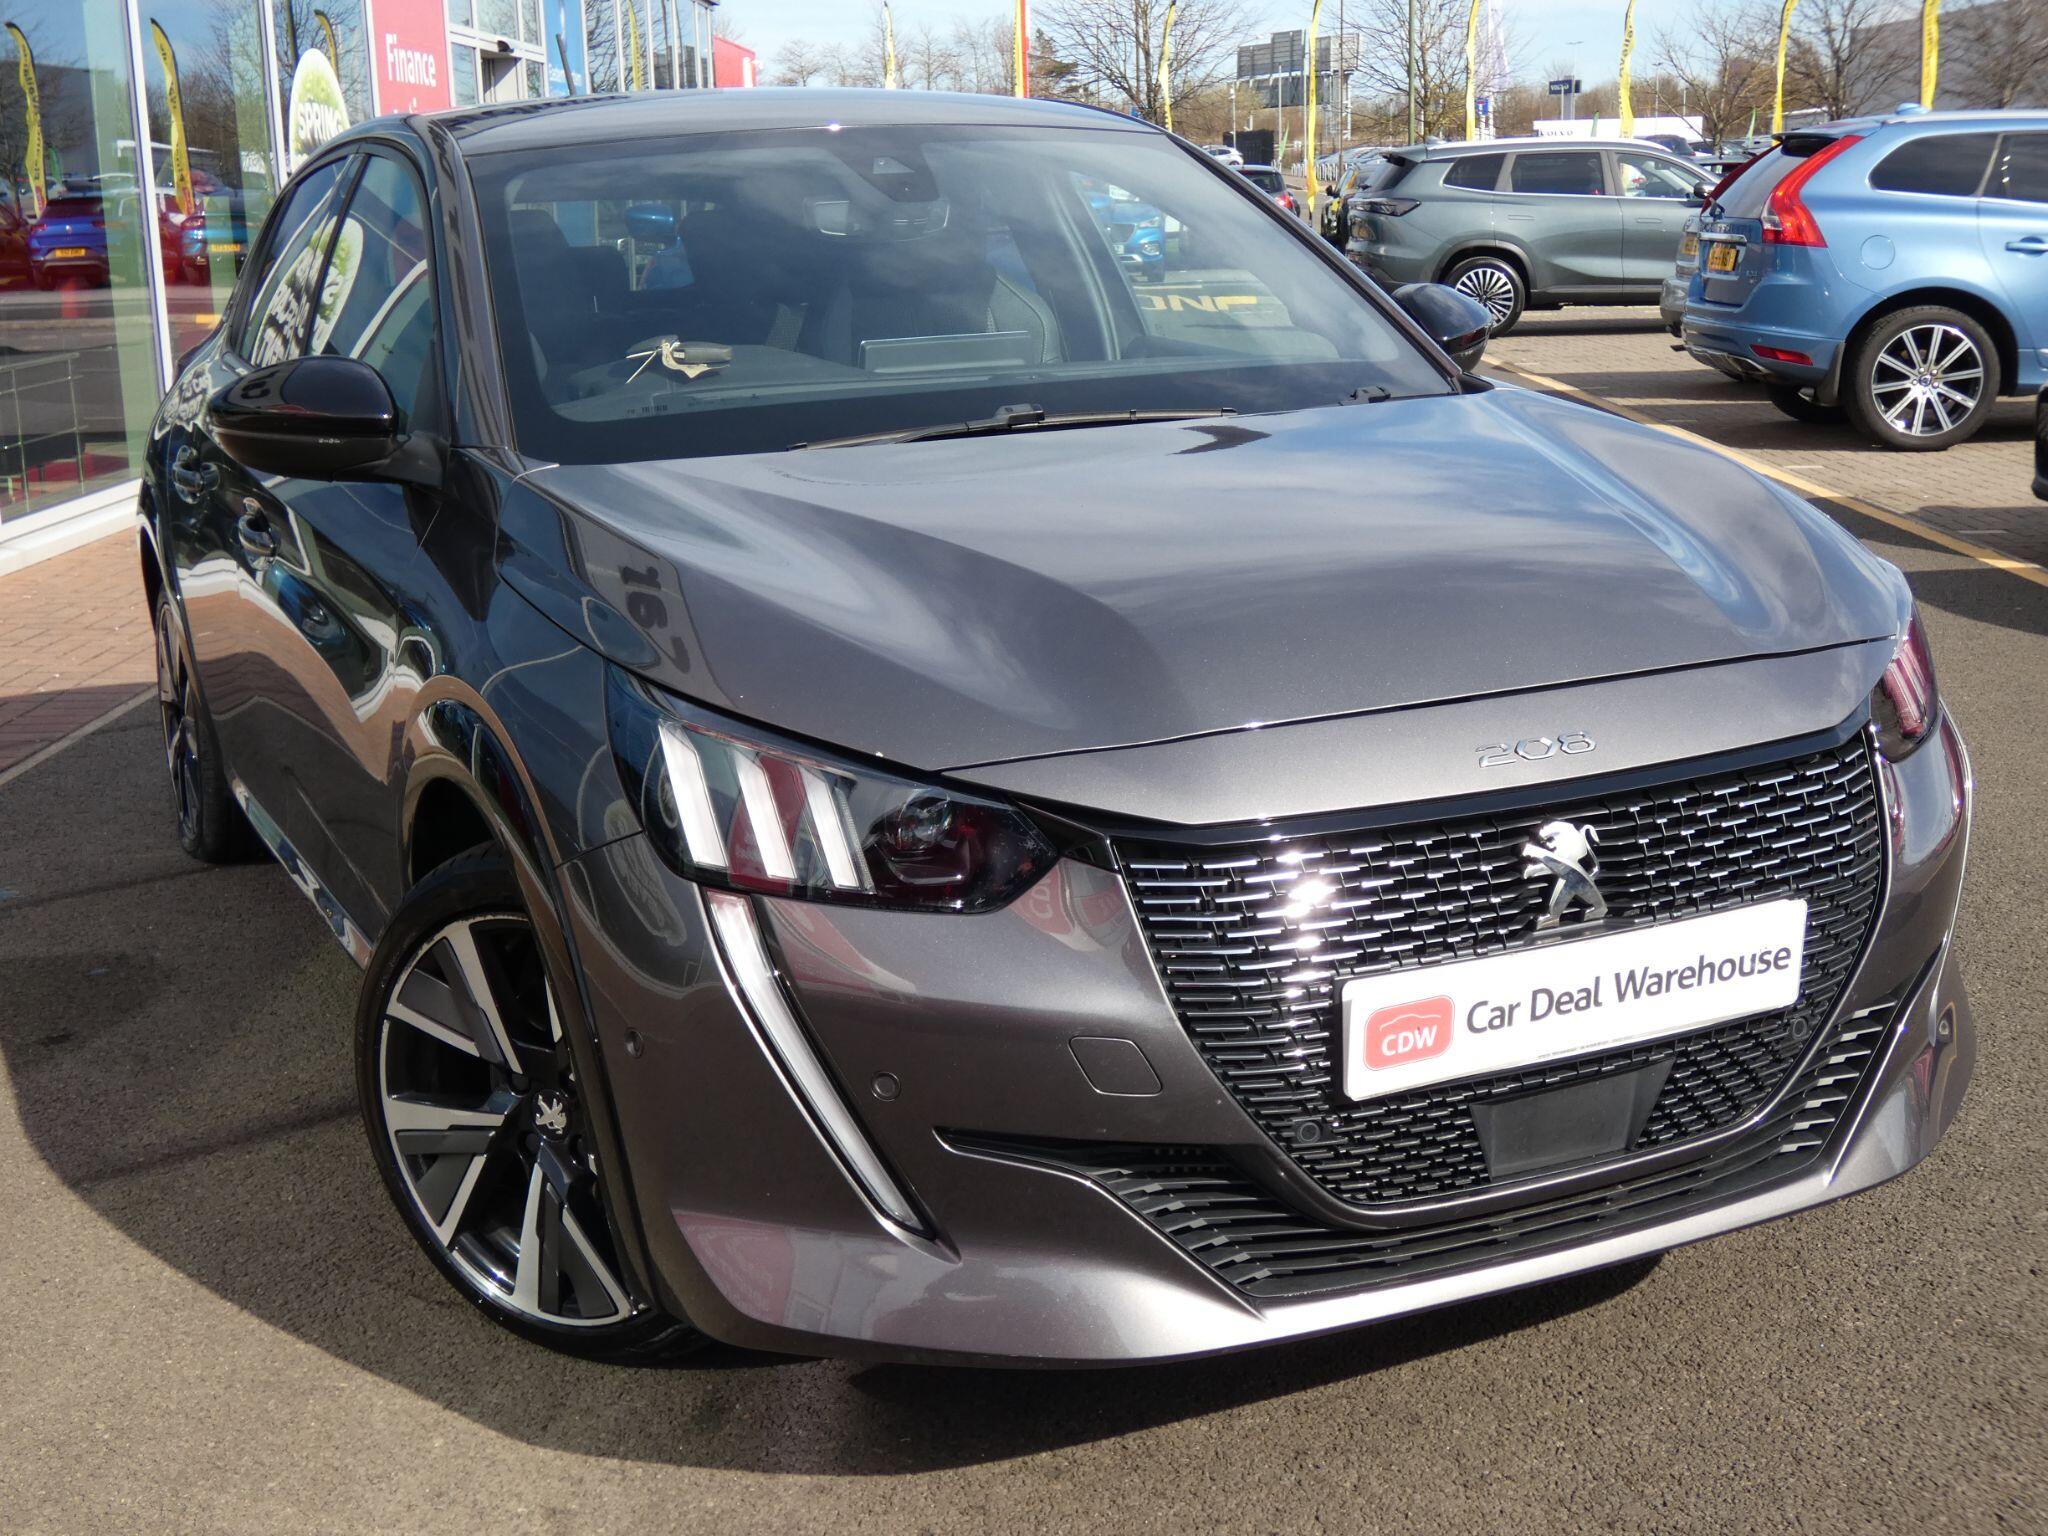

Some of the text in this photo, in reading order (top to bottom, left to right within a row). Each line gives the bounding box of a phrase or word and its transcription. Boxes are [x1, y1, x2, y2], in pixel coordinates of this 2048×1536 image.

[385, 33, 437, 87] Finance
[1475, 731, 1597, 768] 208
[1466, 946, 1792, 1034] Car Deal Warehouse
[1381, 1024, 1438, 1058] CDW
